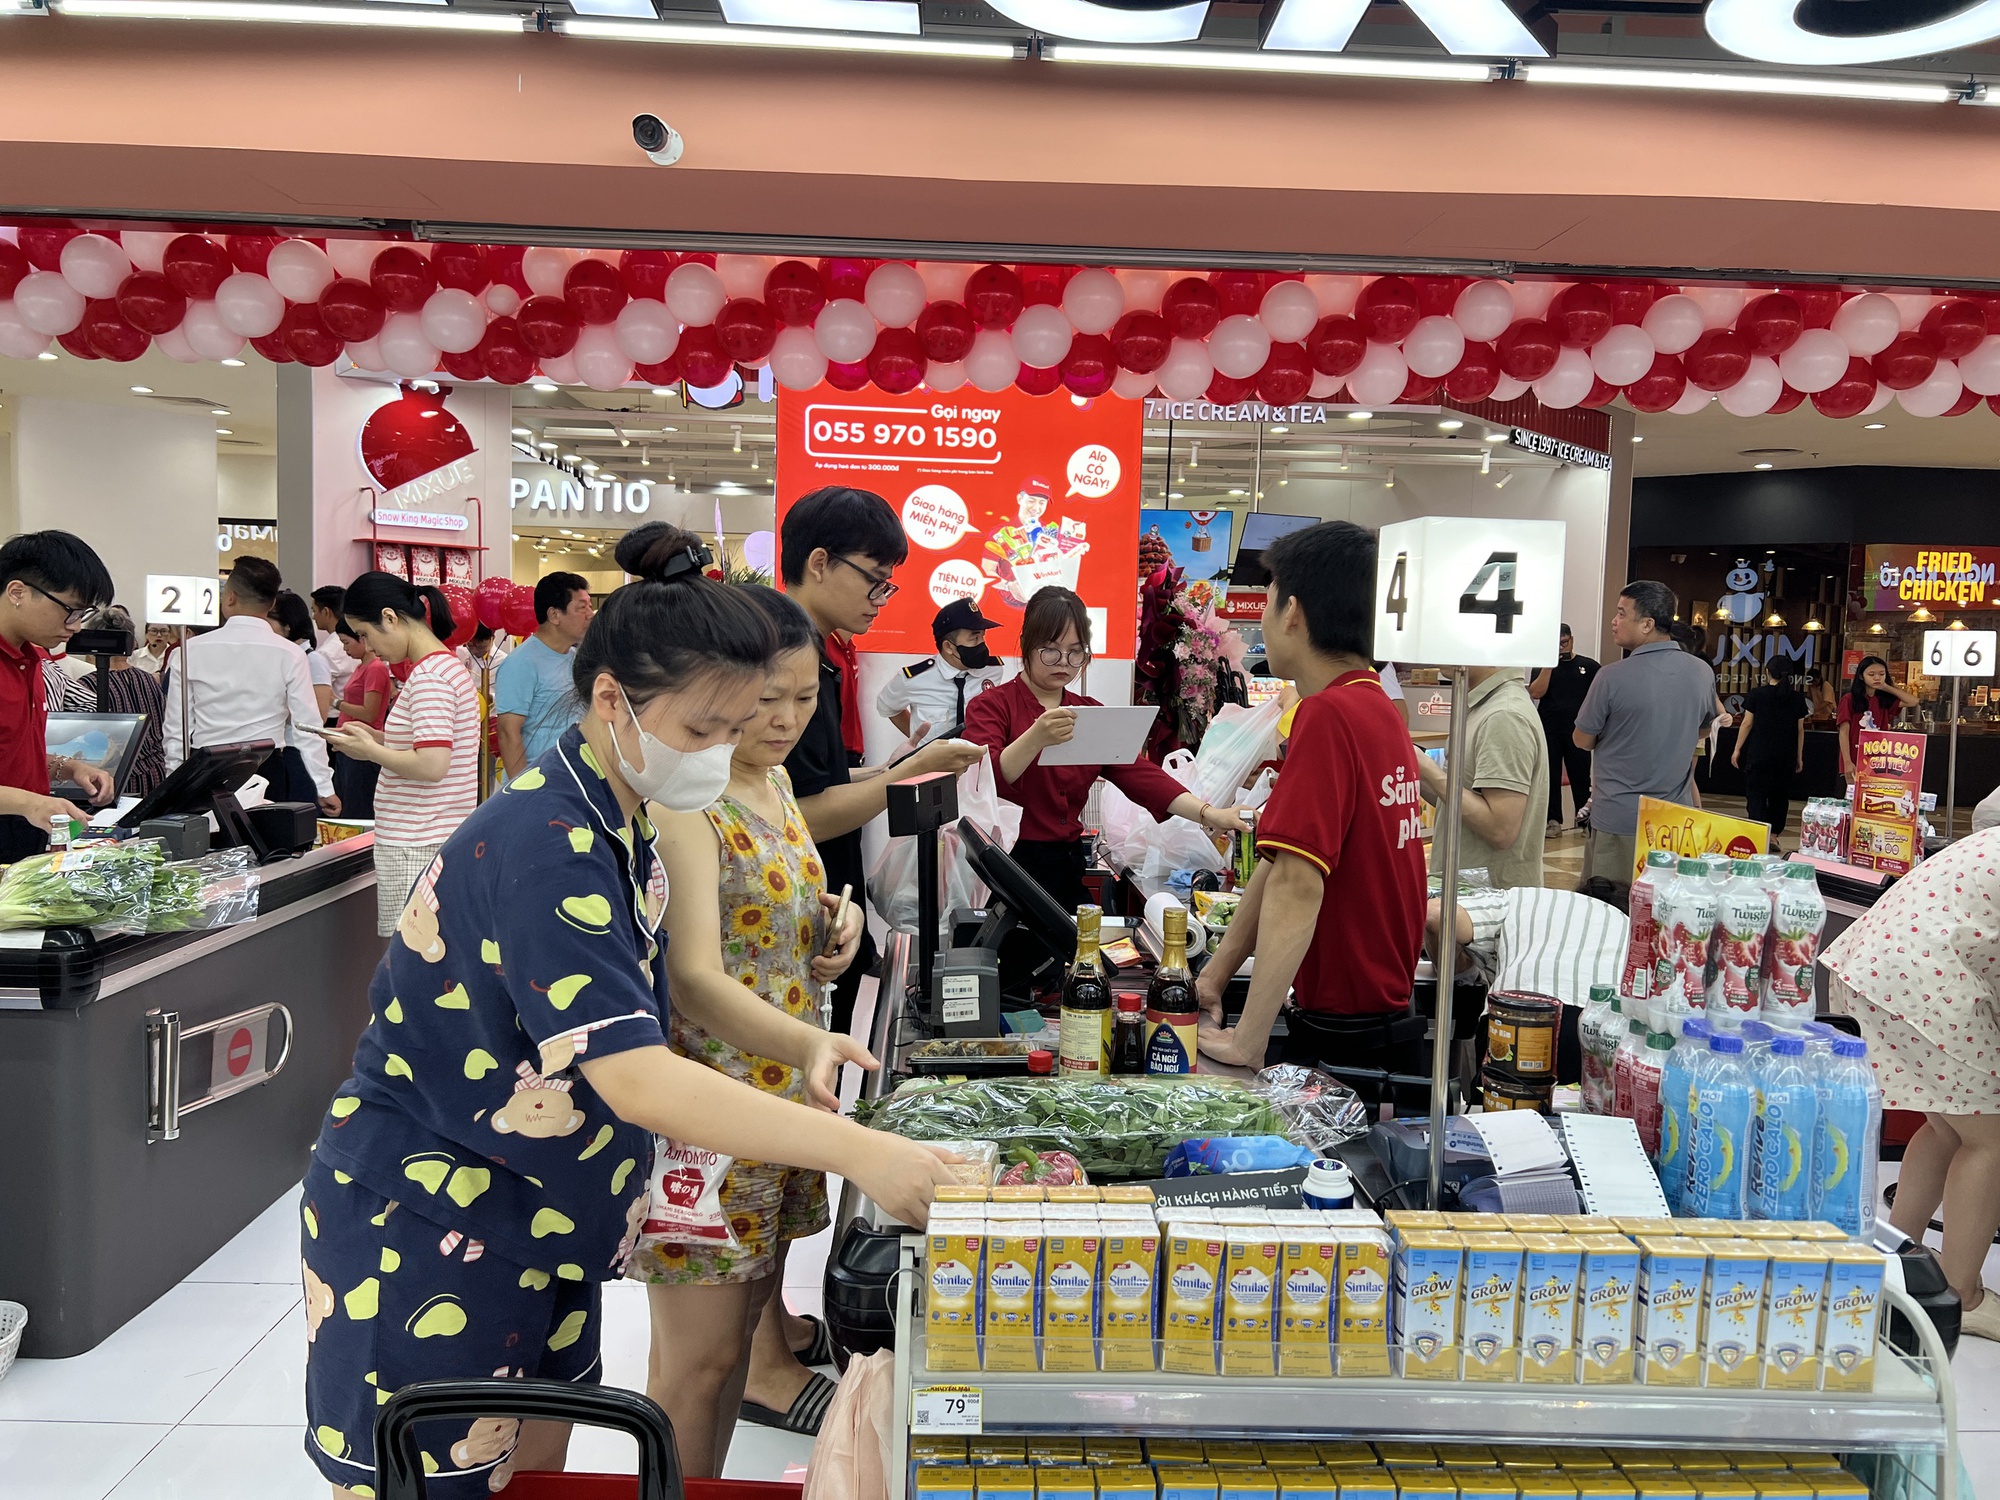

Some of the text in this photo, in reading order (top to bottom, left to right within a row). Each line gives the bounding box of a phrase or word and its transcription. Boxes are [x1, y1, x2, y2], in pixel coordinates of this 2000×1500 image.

[931, 403, 1001, 424] Gọi ngay
[813, 420, 997, 449] 055 970 1590
[1515, 428, 1539, 450] SINCE
[1088, 450, 1108, 463] Alo
[1086, 461, 1104, 476] CÓ
[394, 458, 476, 510] MIXUE
[1072, 473, 1110, 490] NGAY!
[510, 477, 650, 514] PANTIO
[377, 511, 464, 528] Snow King Magic Shop
[911, 496, 966, 525] Giao hàng
[908, 510, 958, 536] MIỄN PHÍ
[1916, 551, 1973, 573] FRIED
[1033, 569, 1063, 581] WinMart
[932, 583, 951, 596] mỗi
[1386, 551, 1408, 631] 4
[1459, 551, 1524, 634] 4
[1899, 580, 1985, 602] CHICKEN
[161, 585, 181, 614] 2
[203, 587, 213, 615] 2
[1236, 601, 1267, 610] MIXUE
[1930, 640, 1943, 666] 6
[1963, 640, 1983, 667] 6
[1863, 738, 1919, 760] NGÔI SAO
[1869, 756, 1887, 769] CHI
[1655, 817, 1698, 859] GIÁ
[1731, 906, 1771, 921] Twister
[1780, 903, 1823, 922] Twister
[1499, 1029, 1511, 1039] Rim
[1151, 1052, 1178, 1064] CÁ NGỪ
[1163, 1063, 1180, 1073] NGƯ
[1495, 1101, 1508, 1110] Rim
[1693, 1101, 1714, 1214] ZERO CALO
[1762, 1103, 1784, 1216] ZERO CALO
[1174, 1190, 1219, 1206] KHÁCH
[1221, 1186, 1259, 1202] HÀNG
[1260, 1181, 1290, 1198] TIẾP
[933, 1274, 973, 1287] Similac
[990, 1274, 1031, 1287] Similac
[1050, 1275, 1090, 1287] Similac
[1109, 1275, 1149, 1287] Similac
[1172, 1276, 1212, 1290] Similac
[1230, 1280, 1270, 1293] Similac
[1286, 1281, 1327, 1293] Similac
[1344, 1281, 1384, 1293] Similac
[1411, 1279, 1453, 1297] GROW
[1471, 1281, 1513, 1299] GROW
[1529, 1283, 1572, 1301] GROW
[1590, 1283, 1631, 1302] GROW
[1653, 1287, 1696, 1305] GROW
[1715, 1289, 1758, 1307] GROW
[1774, 1292, 1818, 1310] GROW
[1833, 1293, 1875, 1311] GROW
[945, 1398, 966, 1414] 79
